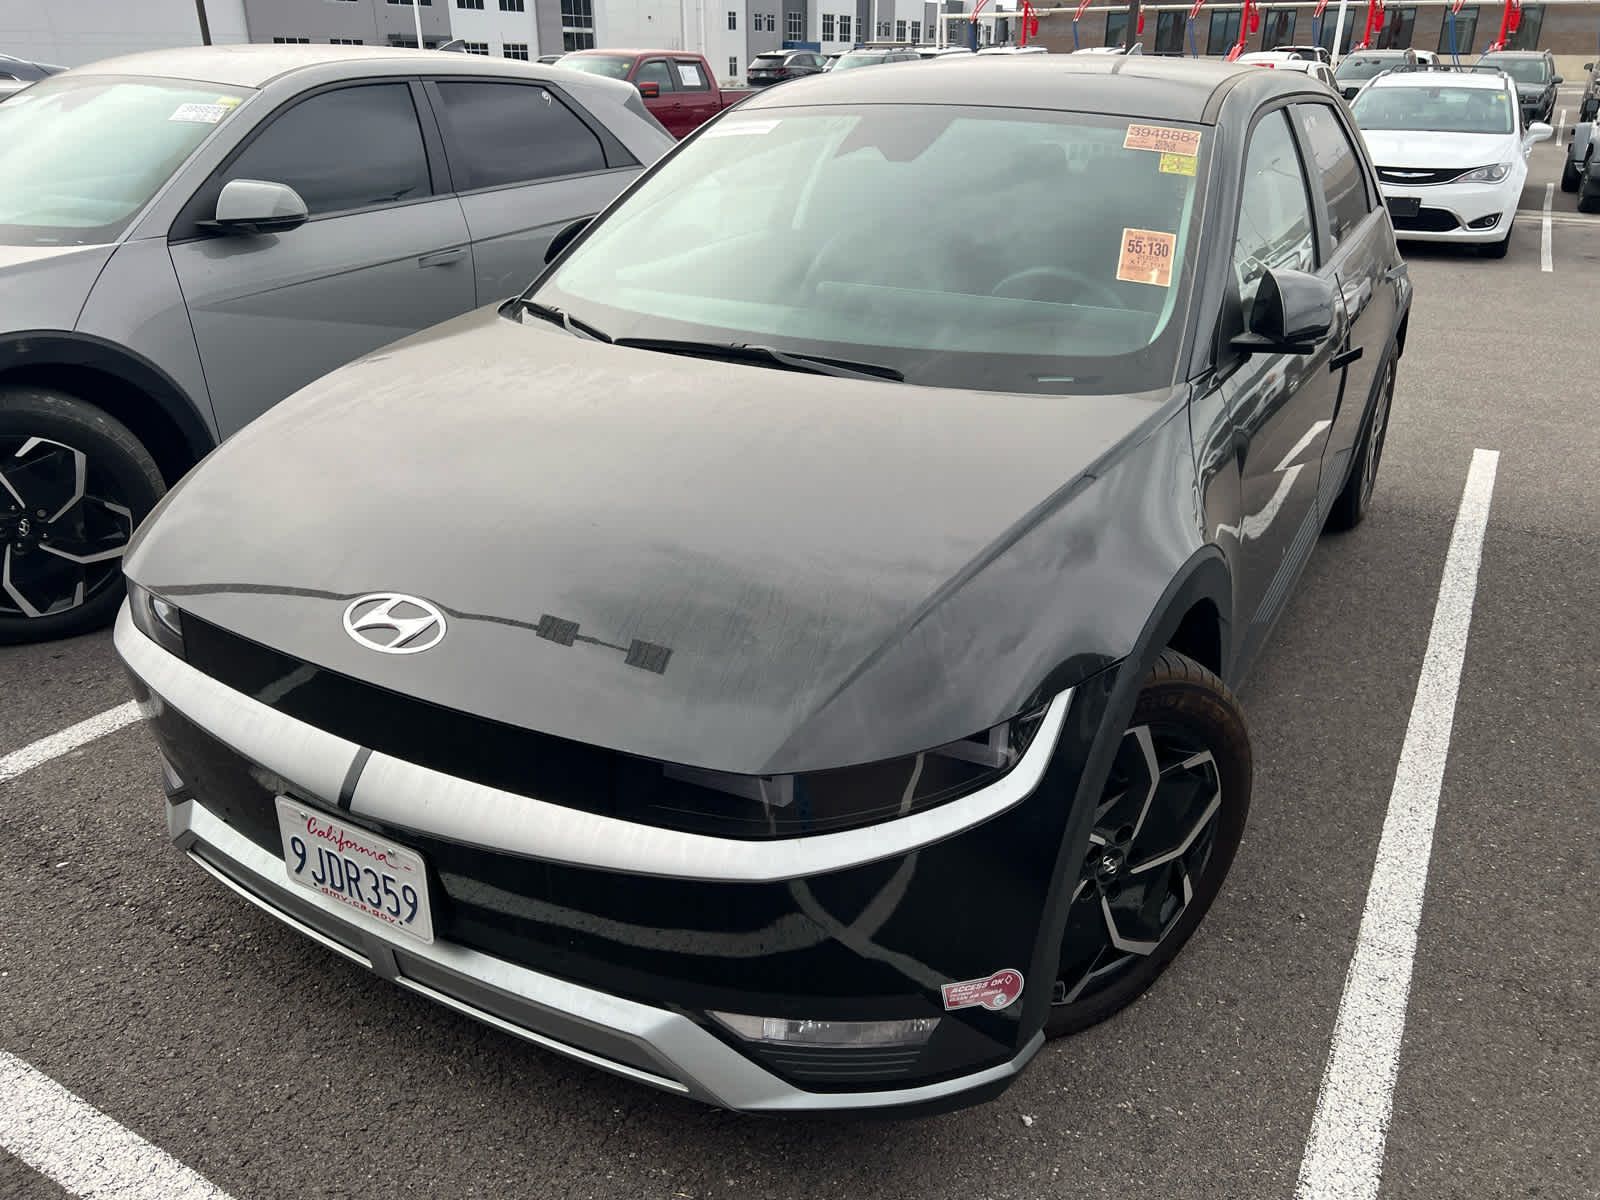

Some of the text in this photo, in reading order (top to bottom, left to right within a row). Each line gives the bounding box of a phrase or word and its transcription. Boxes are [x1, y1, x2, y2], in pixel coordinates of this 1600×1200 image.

[1127, 239, 1168, 257] 55:130
[307, 816, 399, 870] California
[290, 836, 418, 925] 9JDR359
[951, 982, 989, 993] ACCESS
[991, 978, 1004, 987] OK
